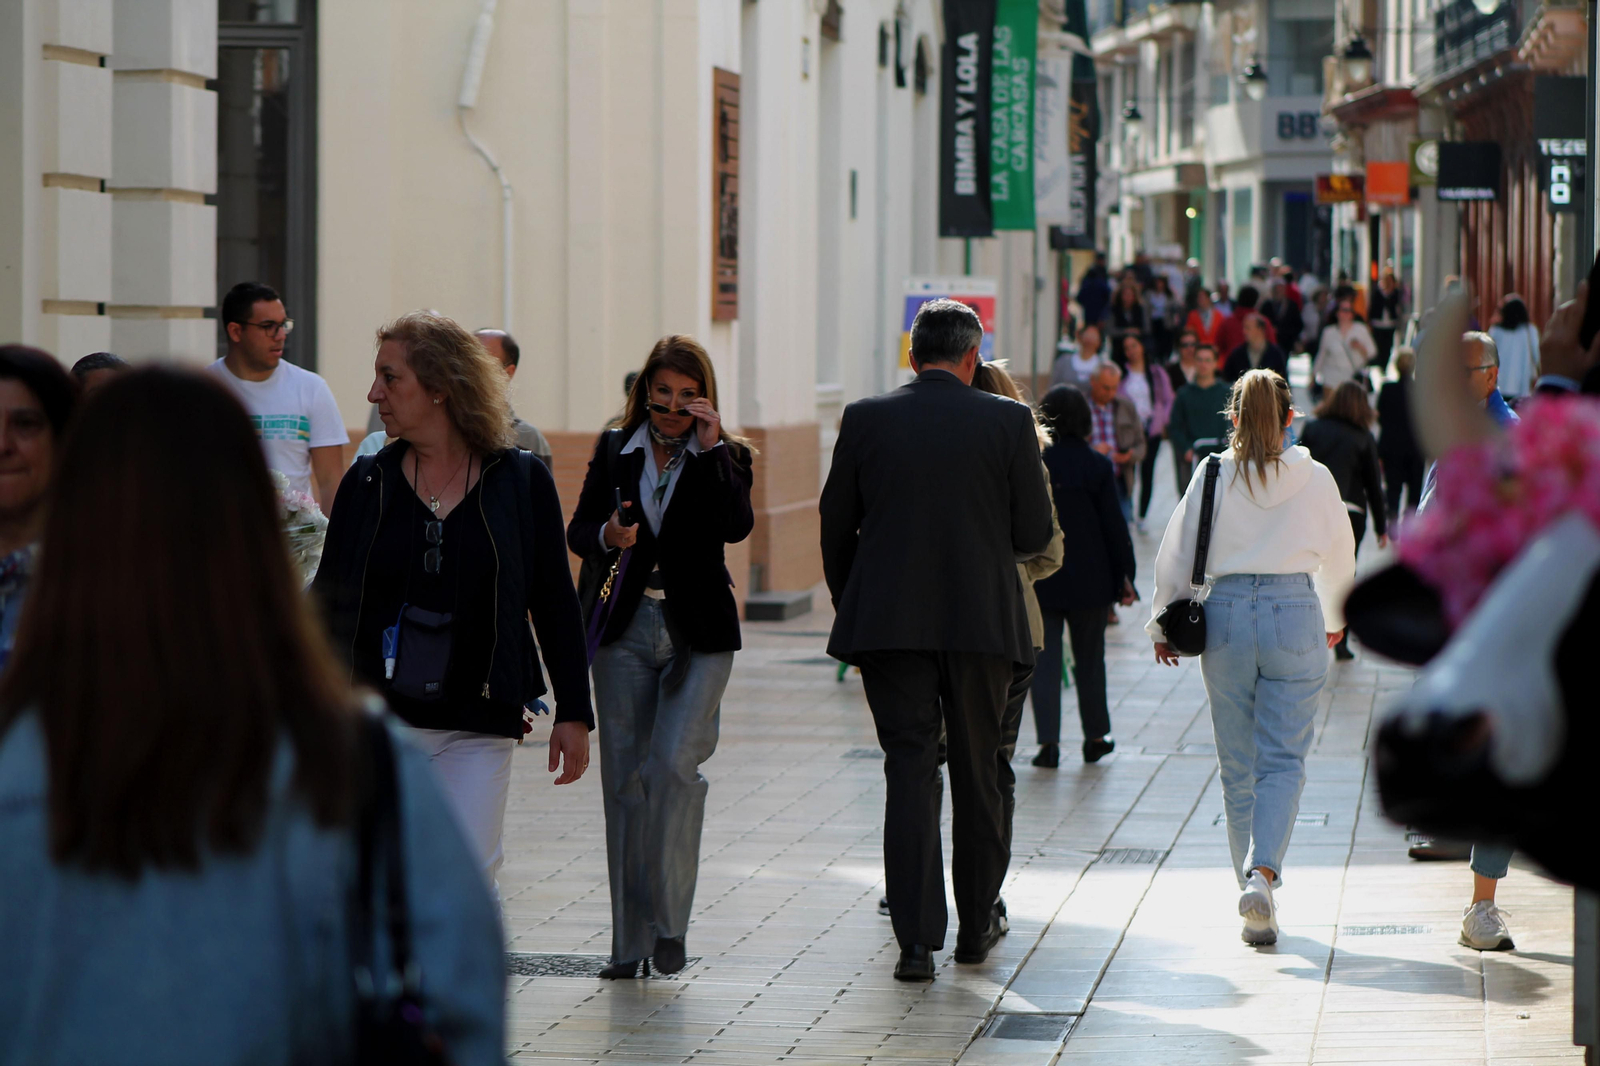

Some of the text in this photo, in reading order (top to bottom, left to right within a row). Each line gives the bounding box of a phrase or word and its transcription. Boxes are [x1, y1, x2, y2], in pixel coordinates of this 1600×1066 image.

[954, 32, 979, 195] BIMBA Y LOLA
[991, 25, 1012, 201] LA CASA DE LAS
